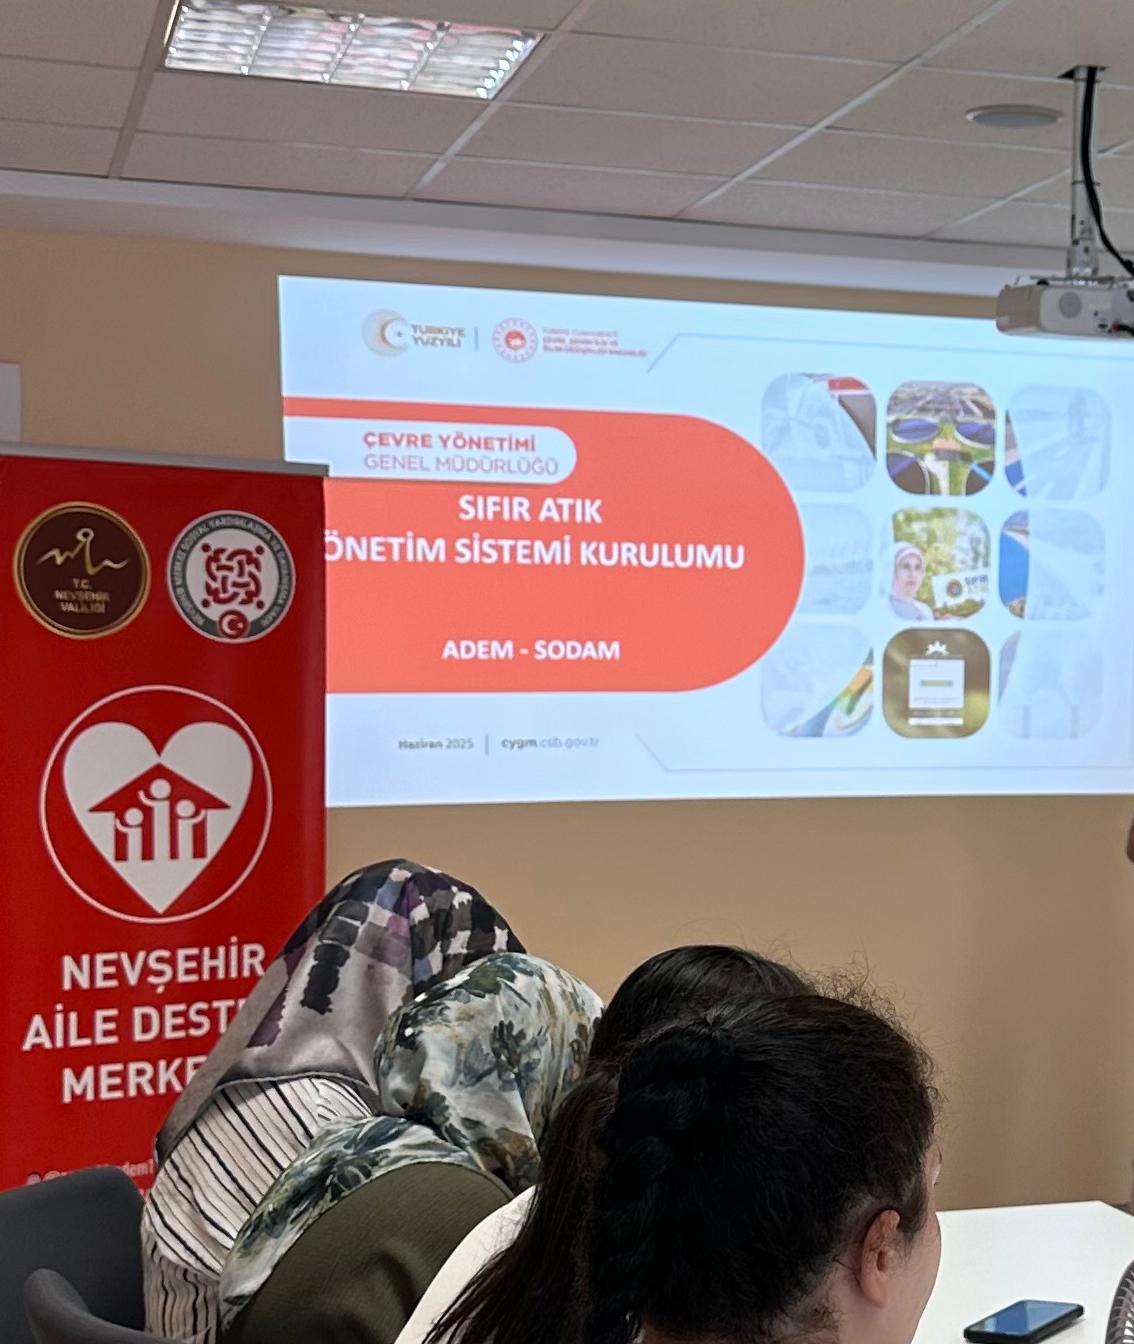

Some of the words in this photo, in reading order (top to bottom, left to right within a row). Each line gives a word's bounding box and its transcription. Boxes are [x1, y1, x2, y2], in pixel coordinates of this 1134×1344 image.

[363, 431, 433, 449] ÇEVRE
[438, 432, 536, 453] YÖNETİMİ
[363, 454, 430, 472] GENEL
[435, 455, 559, 476] MÜDÜRLÜĞÜ
[458, 494, 532, 522] SIFIR
[538, 497, 603, 524] ATIK
[324, 529, 447, 563] ÖNETİM
[454, 531, 572, 565] SİSTEMİ
[580, 540, 745, 570] KURULUMU
[441, 639, 514, 660] ADEM
[534, 639, 621, 661] SODAM
[446, 738, 474, 750] 2025
[62, 935, 266, 995] NEVŞEHİR
[21, 1003, 119, 1052] AİLE
[132, 998, 246, 1044] DEST
